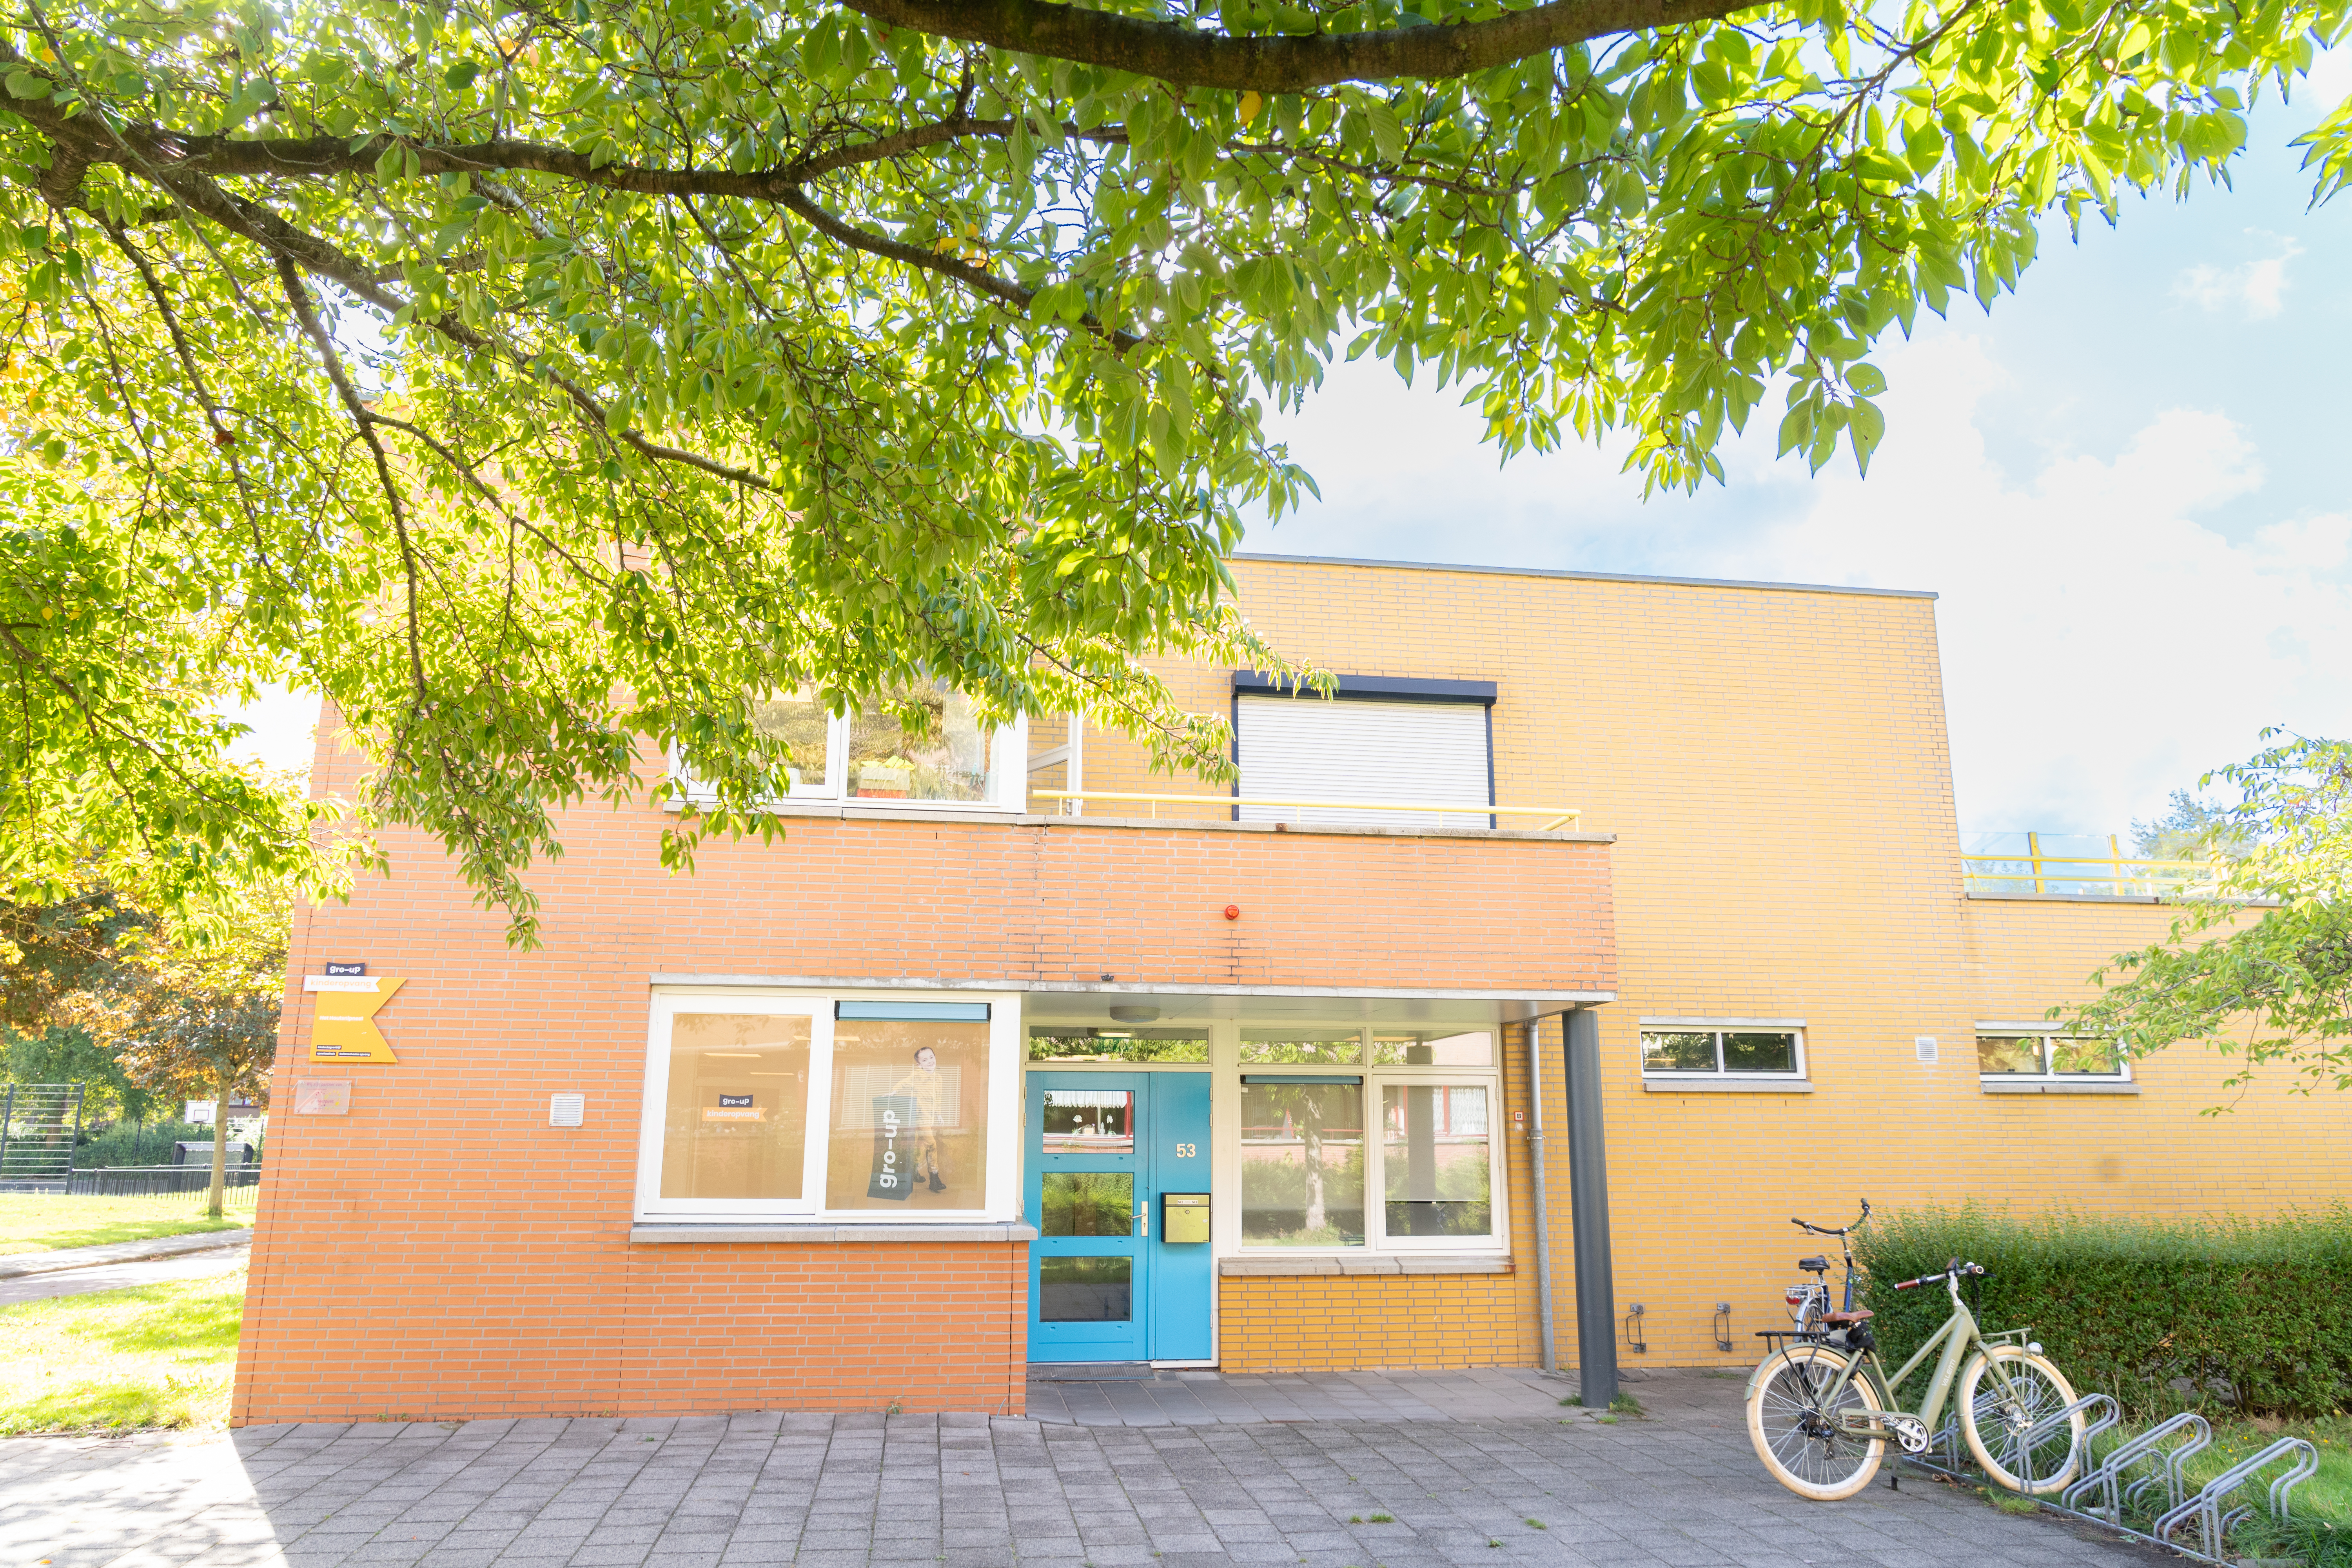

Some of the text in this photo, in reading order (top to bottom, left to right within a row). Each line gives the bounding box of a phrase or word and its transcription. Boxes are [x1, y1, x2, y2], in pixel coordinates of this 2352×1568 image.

[330, 966, 361, 974] gro-up
[311, 979, 371, 989] kinderopvang
[707, 1110, 760, 1119] kinderopvang
[880, 1110, 900, 1188] gro-up
[1176, 1143, 1196, 1158] 53
[1941, 1358, 1956, 1386] VALENTI
